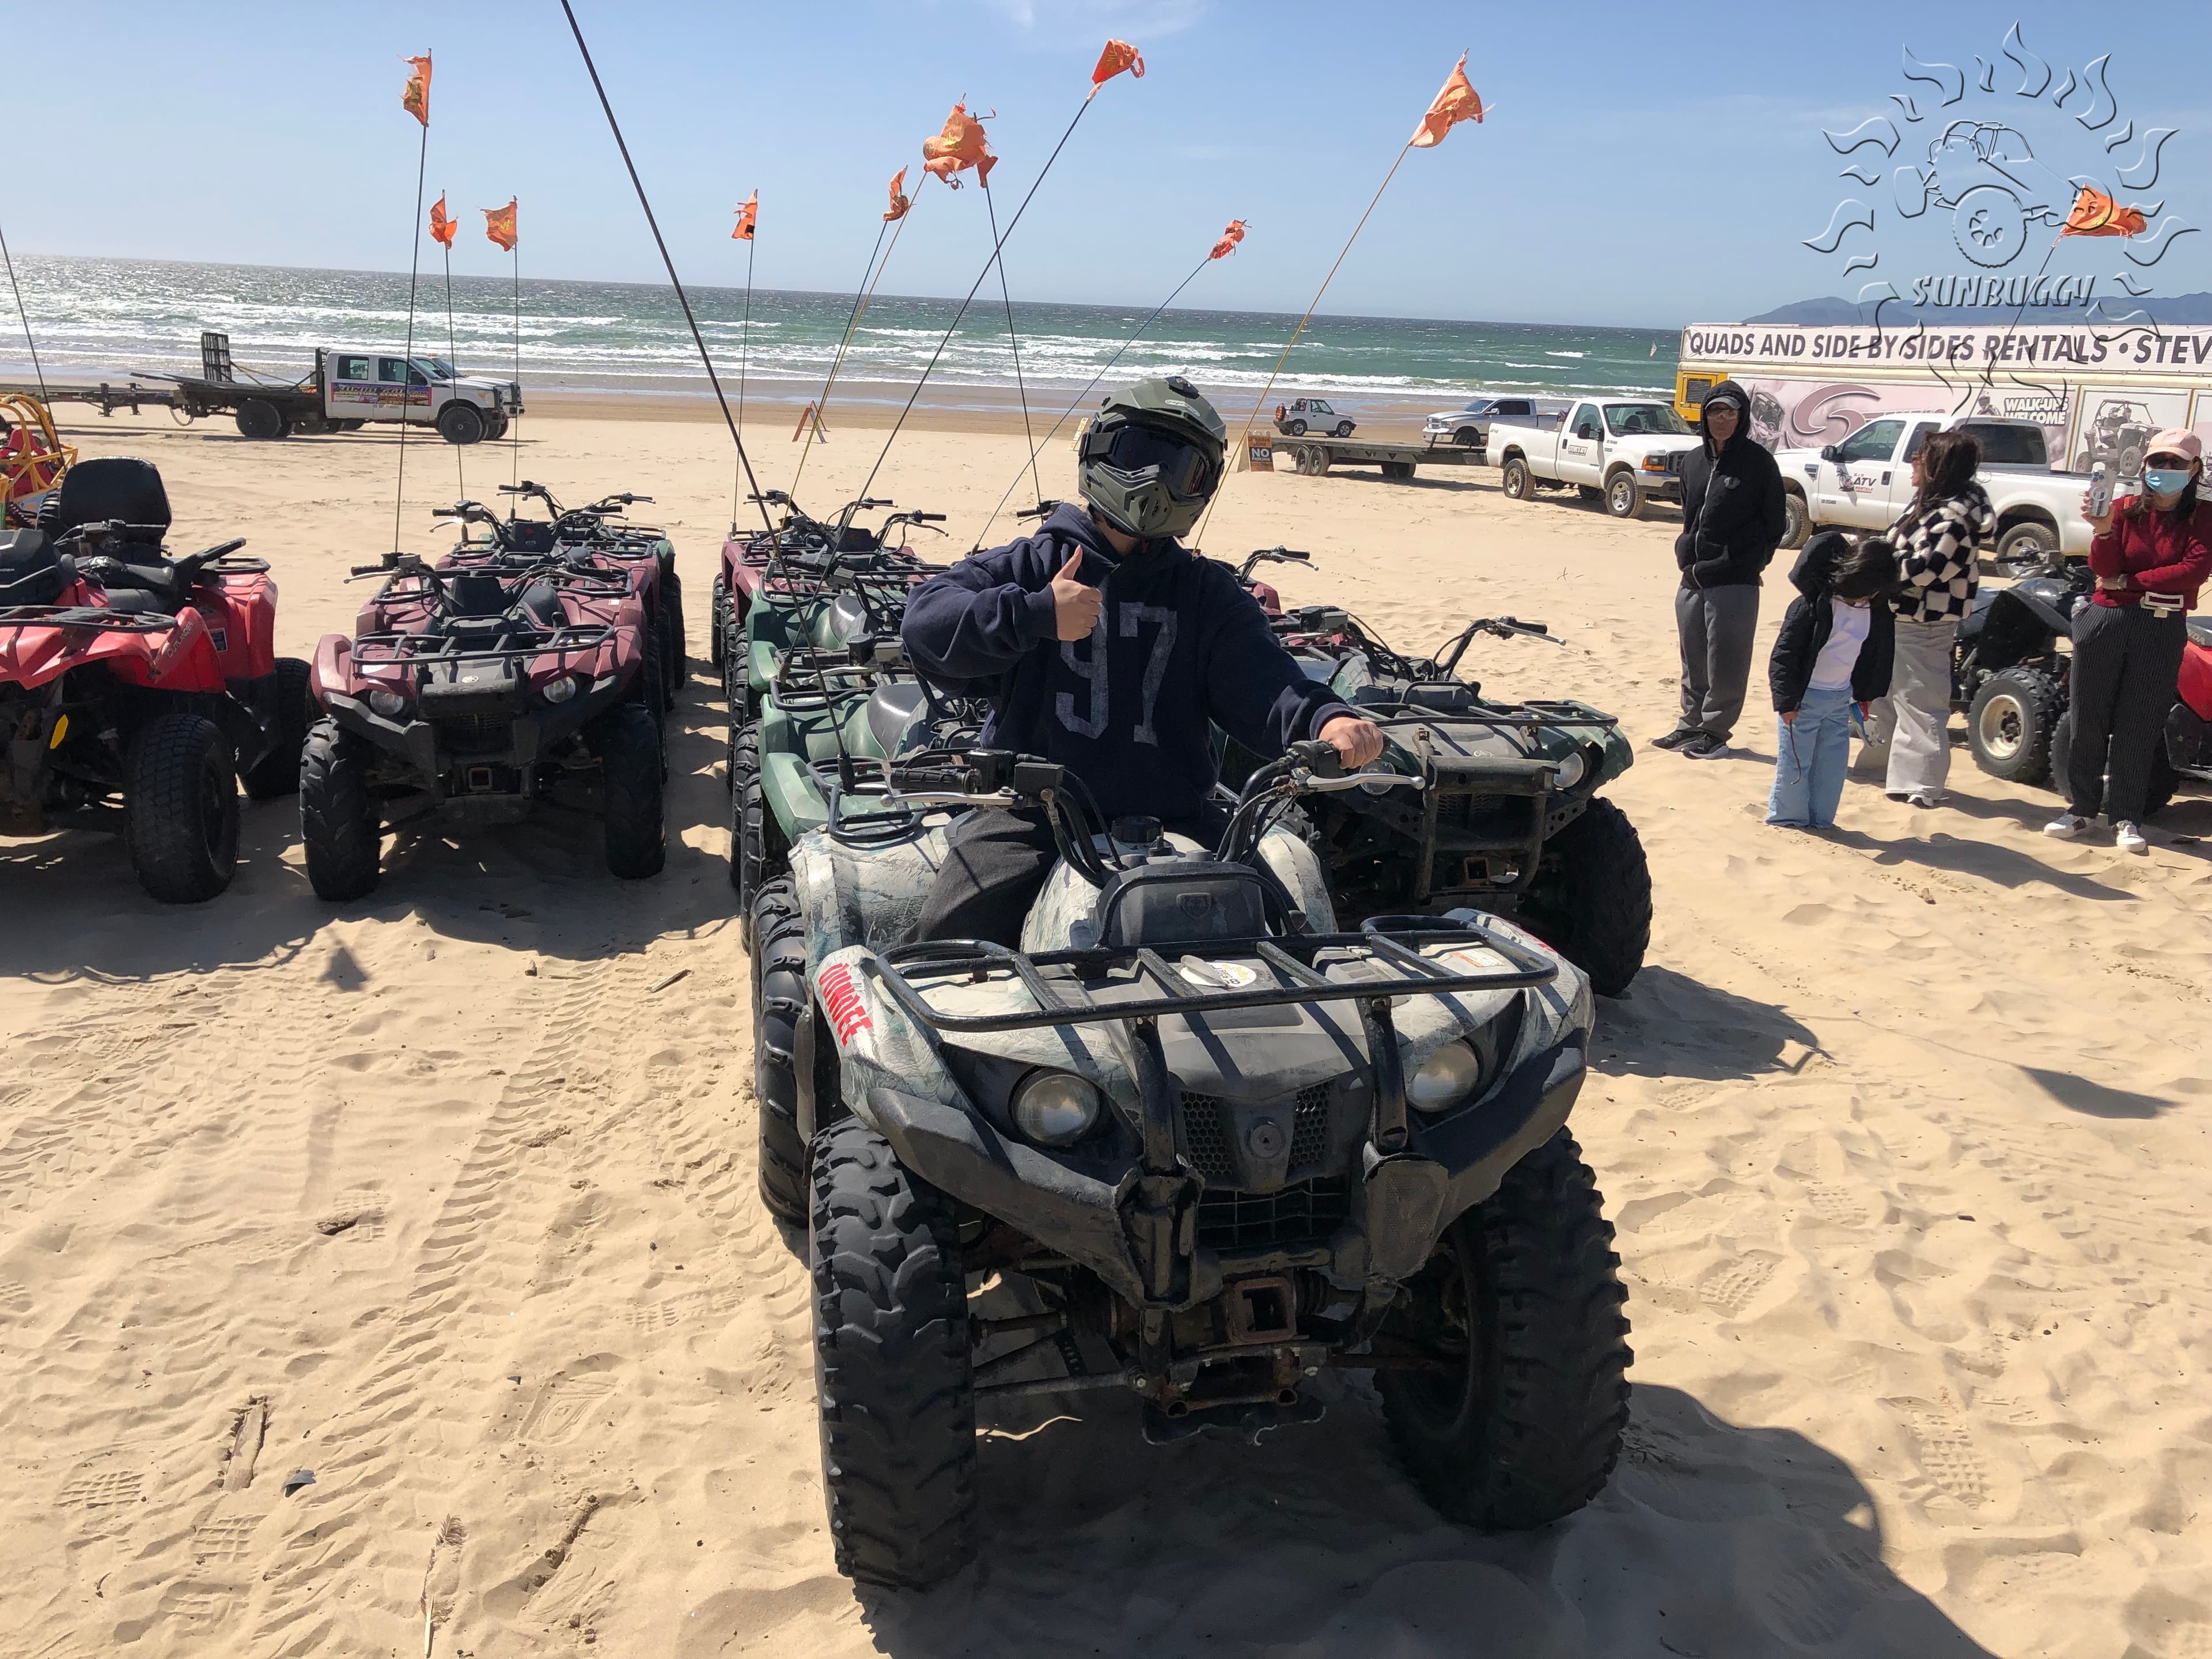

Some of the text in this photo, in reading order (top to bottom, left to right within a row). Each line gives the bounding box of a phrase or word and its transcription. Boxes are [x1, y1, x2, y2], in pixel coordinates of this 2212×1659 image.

[1690, 332, 1755, 355] QUADS
[1759, 334, 1806, 357] AND
[1812, 335, 1862, 358] SIDE
[1866, 335, 1899, 359] BY
[1902, 335, 1975, 360] SIDES
[1982, 334, 2110, 362] RENTALS
[2005, 397, 2069, 411] WALK-UPS
[1251, 448, 1269, 457] NO
[1853, 477, 1877, 487] ATV
[1055, 600, 1177, 747] 97
